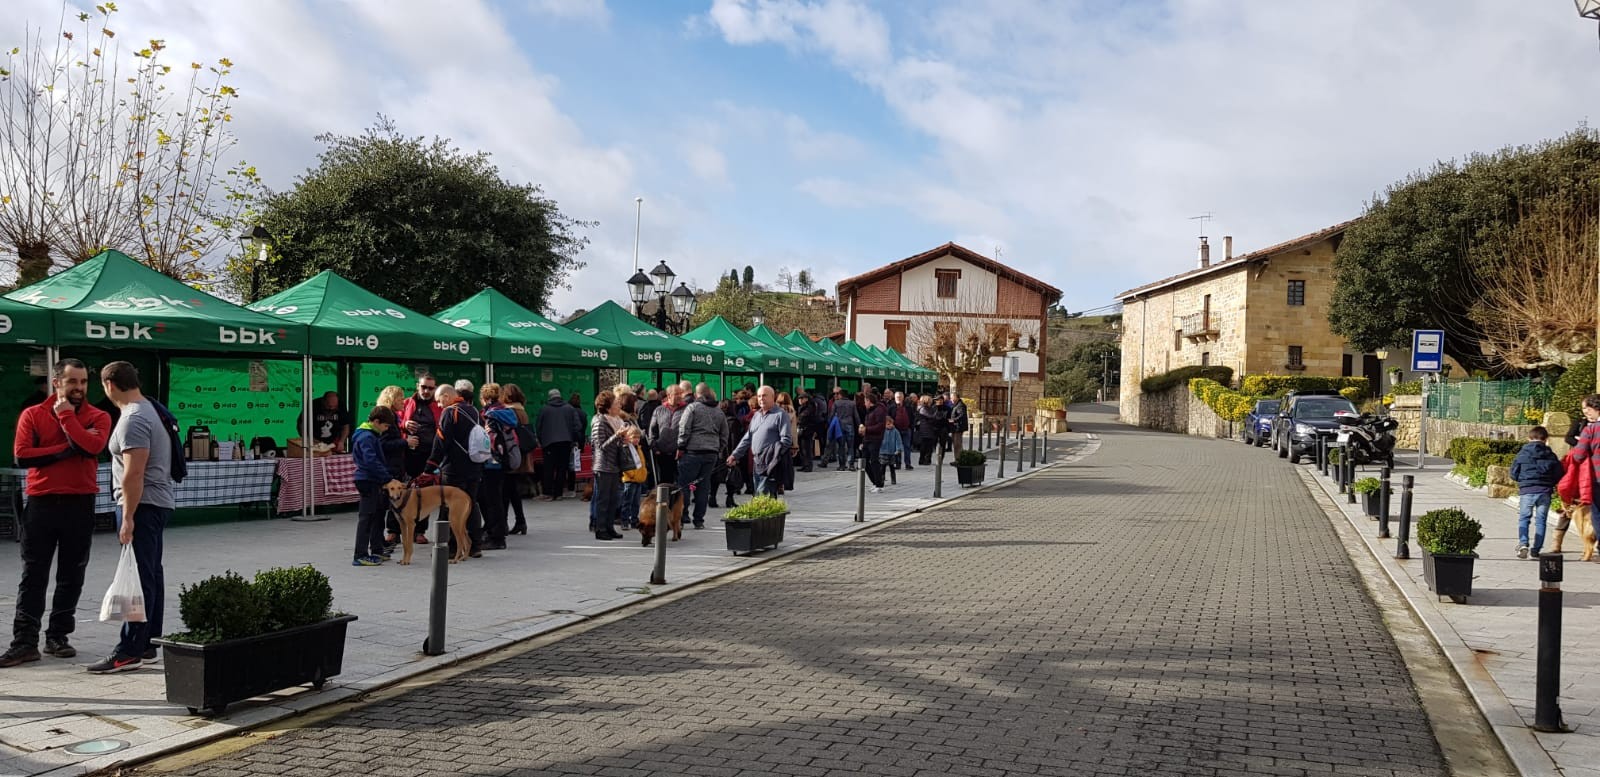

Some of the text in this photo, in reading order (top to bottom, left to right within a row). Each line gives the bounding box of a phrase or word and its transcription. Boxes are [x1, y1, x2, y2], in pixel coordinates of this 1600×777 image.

[93, 294, 193, 309] bbk
[342, 308, 387, 316] bbk
[85, 320, 153, 340] bbk
[219, 326, 276, 345] bbk
[336, 335, 364, 346] bbk
[433, 340, 457, 351] bbk
[510, 344, 531, 355] bbk
[581, 348, 599, 359] bbk
[637, 351, 654, 361] bbk
[691, 354, 706, 363] bbk
